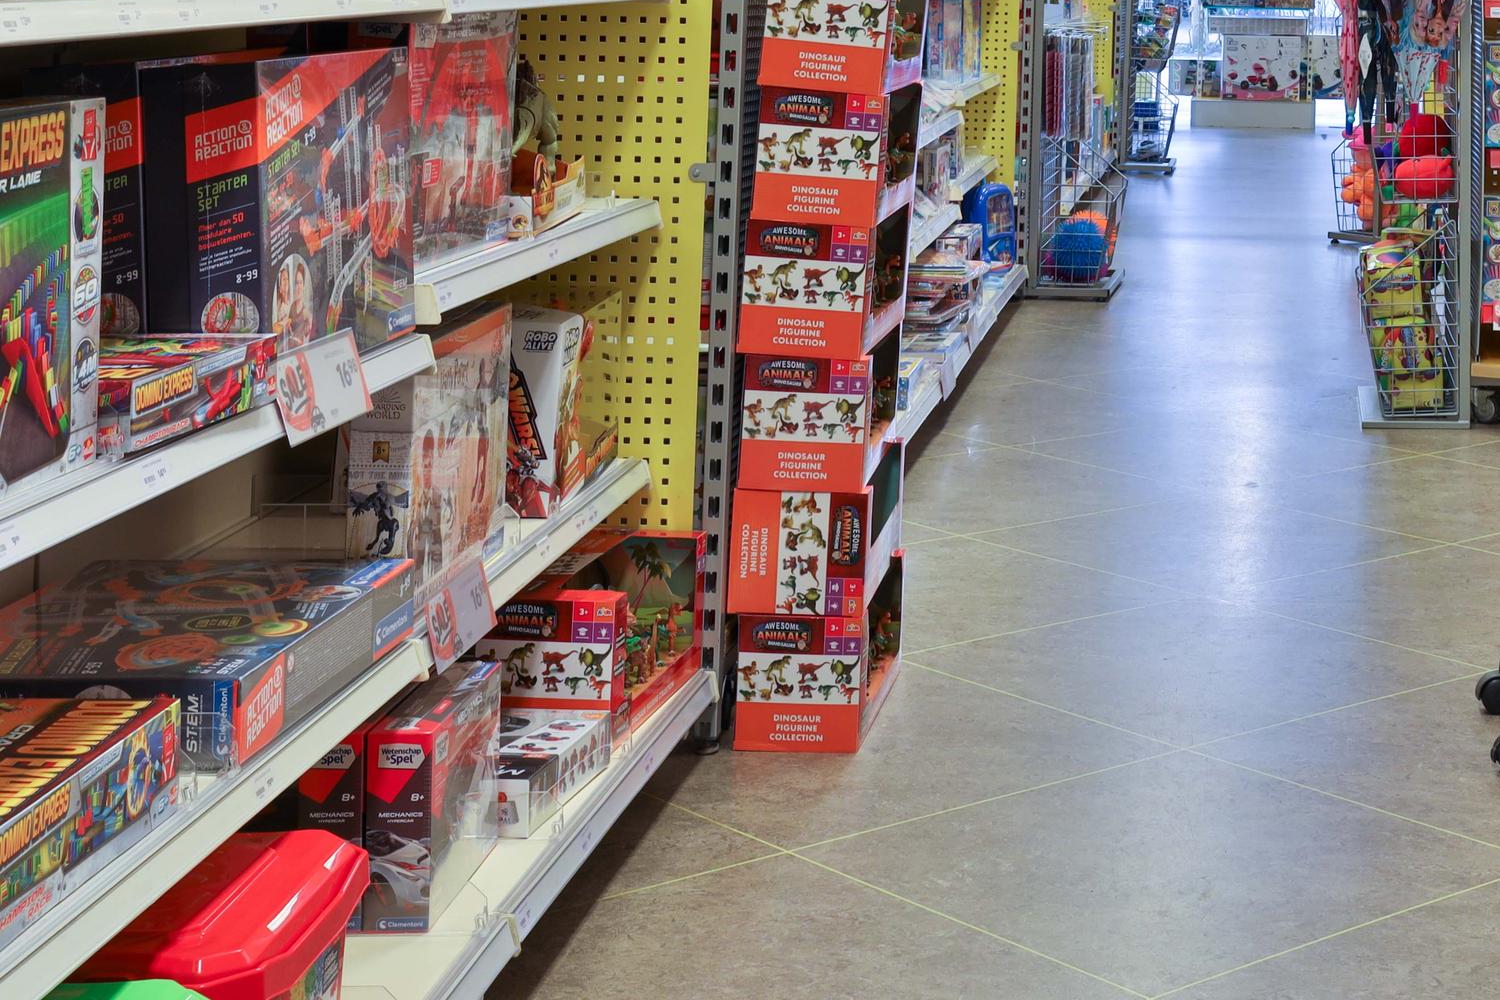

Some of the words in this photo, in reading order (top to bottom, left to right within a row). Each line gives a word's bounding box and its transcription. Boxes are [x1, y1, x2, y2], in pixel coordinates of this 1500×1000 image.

[799, 51, 847, 63] DINOSAUR
[800, 61, 842, 72] FIGURINE
[793, 70, 848, 82] COLLECTION
[778, 103, 829, 115] ANIMALS
[0, 110, 65, 171] EXPRESS
[10, 170, 42, 190] LANE
[791, 185, 840, 197] DINOSAUR
[793, 195, 835, 206] FIGURINE
[786, 203, 841, 216] COLLECTION
[764, 235, 816, 247] ANIMALS
[236, 269, 258, 284] 8-99
[777, 317, 825, 329] DINOSAUR
[779, 327, 821, 338] FIGURINE
[524, 341, 555, 351] ALIVE
[772, 335, 827, 347] COLLECTION
[762, 368, 814, 381] ANIMALS
[135, 376, 162, 415] DOMINO
[164, 366, 194, 401] EXPRESS
[373, 402, 406, 411] ARDING
[367, 410, 402, 420] WORLD
[777, 451, 825, 462] DINOSAUR
[780, 460, 822, 471] FIGURINE
[773, 469, 828, 480] COLLECTION
[740, 523, 750, 579] COLLECTION
[750, 529, 759, 573] FIGURINE
[760, 527, 769, 577] DINOSAUR
[497, 615, 553, 626] ANIMALS
[757, 630, 808, 641] ANIMALS
[773, 714, 821, 723] DINOSAUR
[776, 723, 817, 733] FIGURINE
[769, 733, 824, 742] COLLECTION
[326, 748, 353, 757] nschap
[381, 744, 422, 757] Wetenschap
[411, 793, 424, 802] 8+
[32, 783, 70, 840] EXPRESS
[309, 811, 354, 819] MECHANICS
[378, 811, 423, 819] MECHANICS
[388, 921, 424, 929] Clementoni
